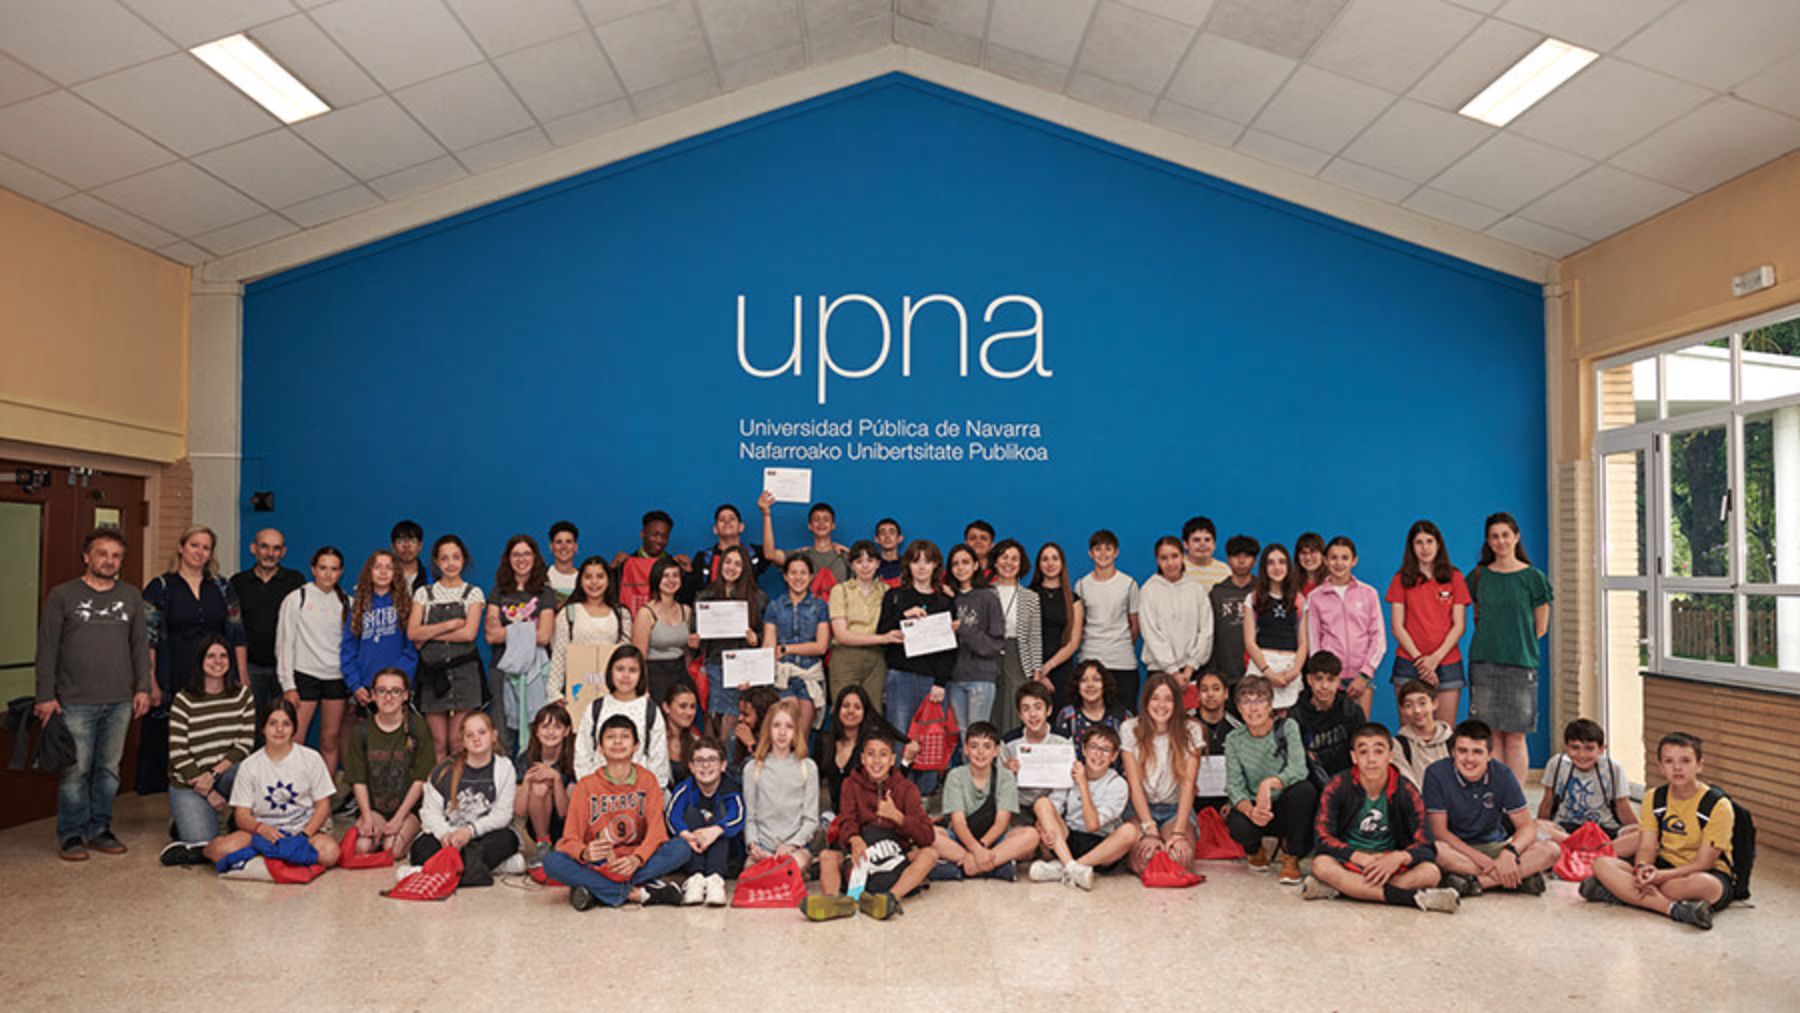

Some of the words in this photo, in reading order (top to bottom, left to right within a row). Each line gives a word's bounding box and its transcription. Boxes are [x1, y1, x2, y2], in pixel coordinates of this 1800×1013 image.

[737, 293, 1053, 405] upna
[740, 418, 852, 437] Universidad
[859, 418, 929, 437] Pública
[935, 419, 961, 437] de
[966, 419, 1041, 437] Navarra
[740, 442, 842, 461] Nafarroako
[848, 442, 963, 461] Unibertsitate
[969, 442, 1048, 461] Publikoa
